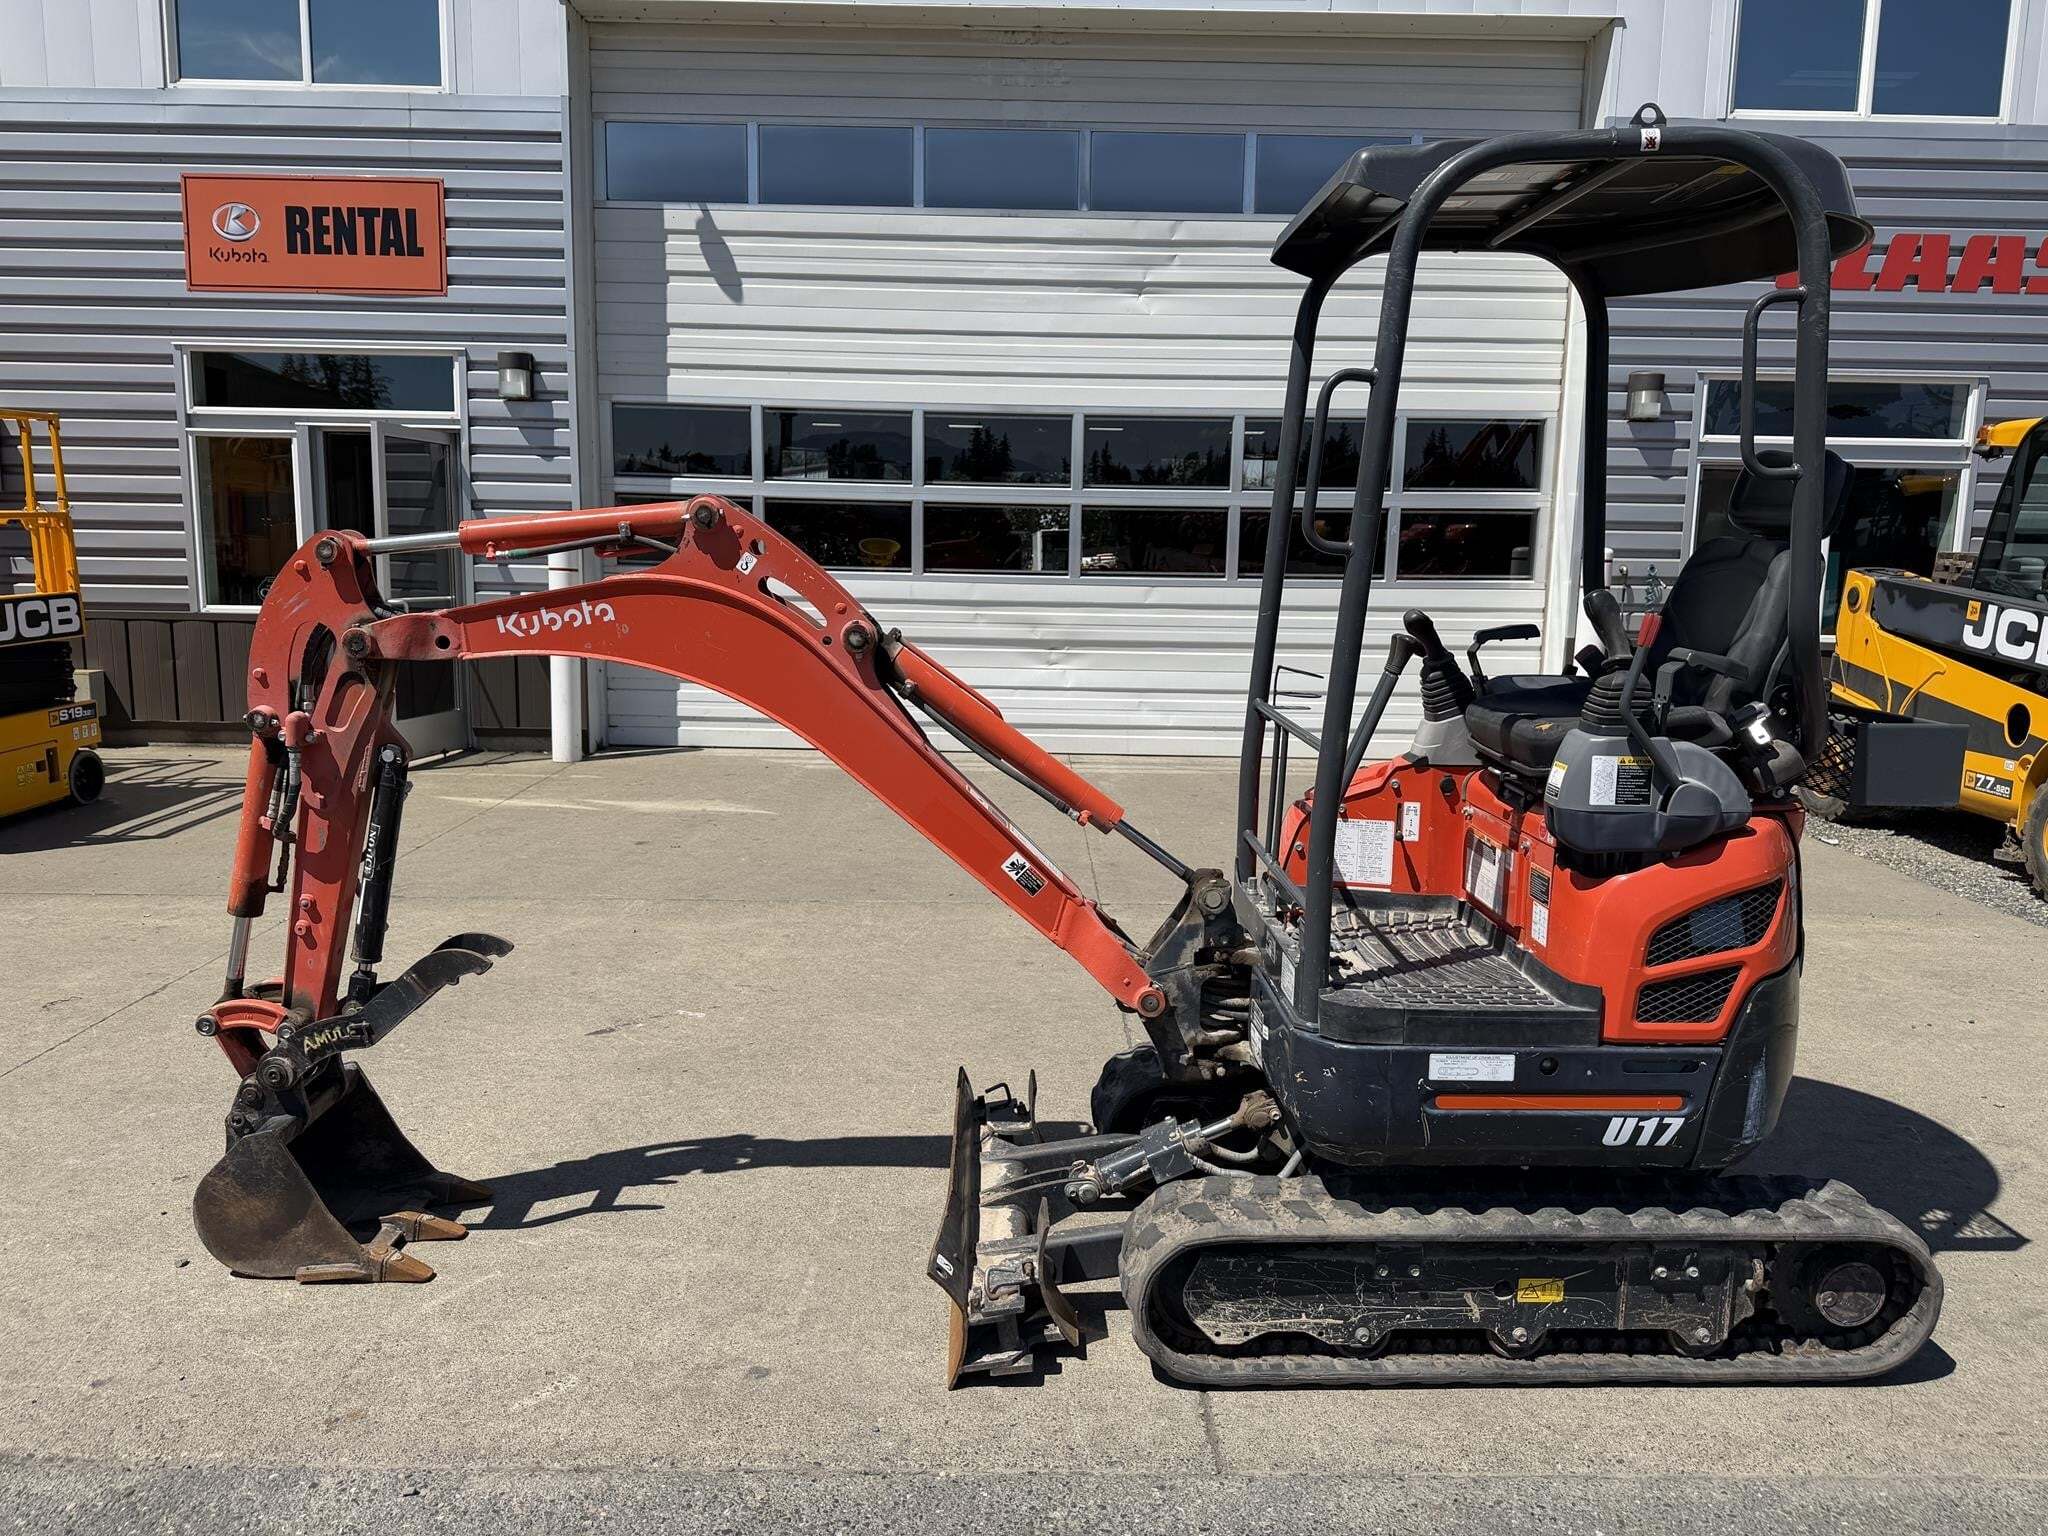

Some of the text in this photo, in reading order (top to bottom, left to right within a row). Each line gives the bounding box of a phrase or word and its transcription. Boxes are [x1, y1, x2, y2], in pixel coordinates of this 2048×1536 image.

[285, 205, 425, 257] RENTAL
[209, 247, 268, 263] Kubota
[1775, 233, 2048, 294] LAA
[496, 599, 616, 637] Kubota
[1602, 1117, 1685, 1146] U17
